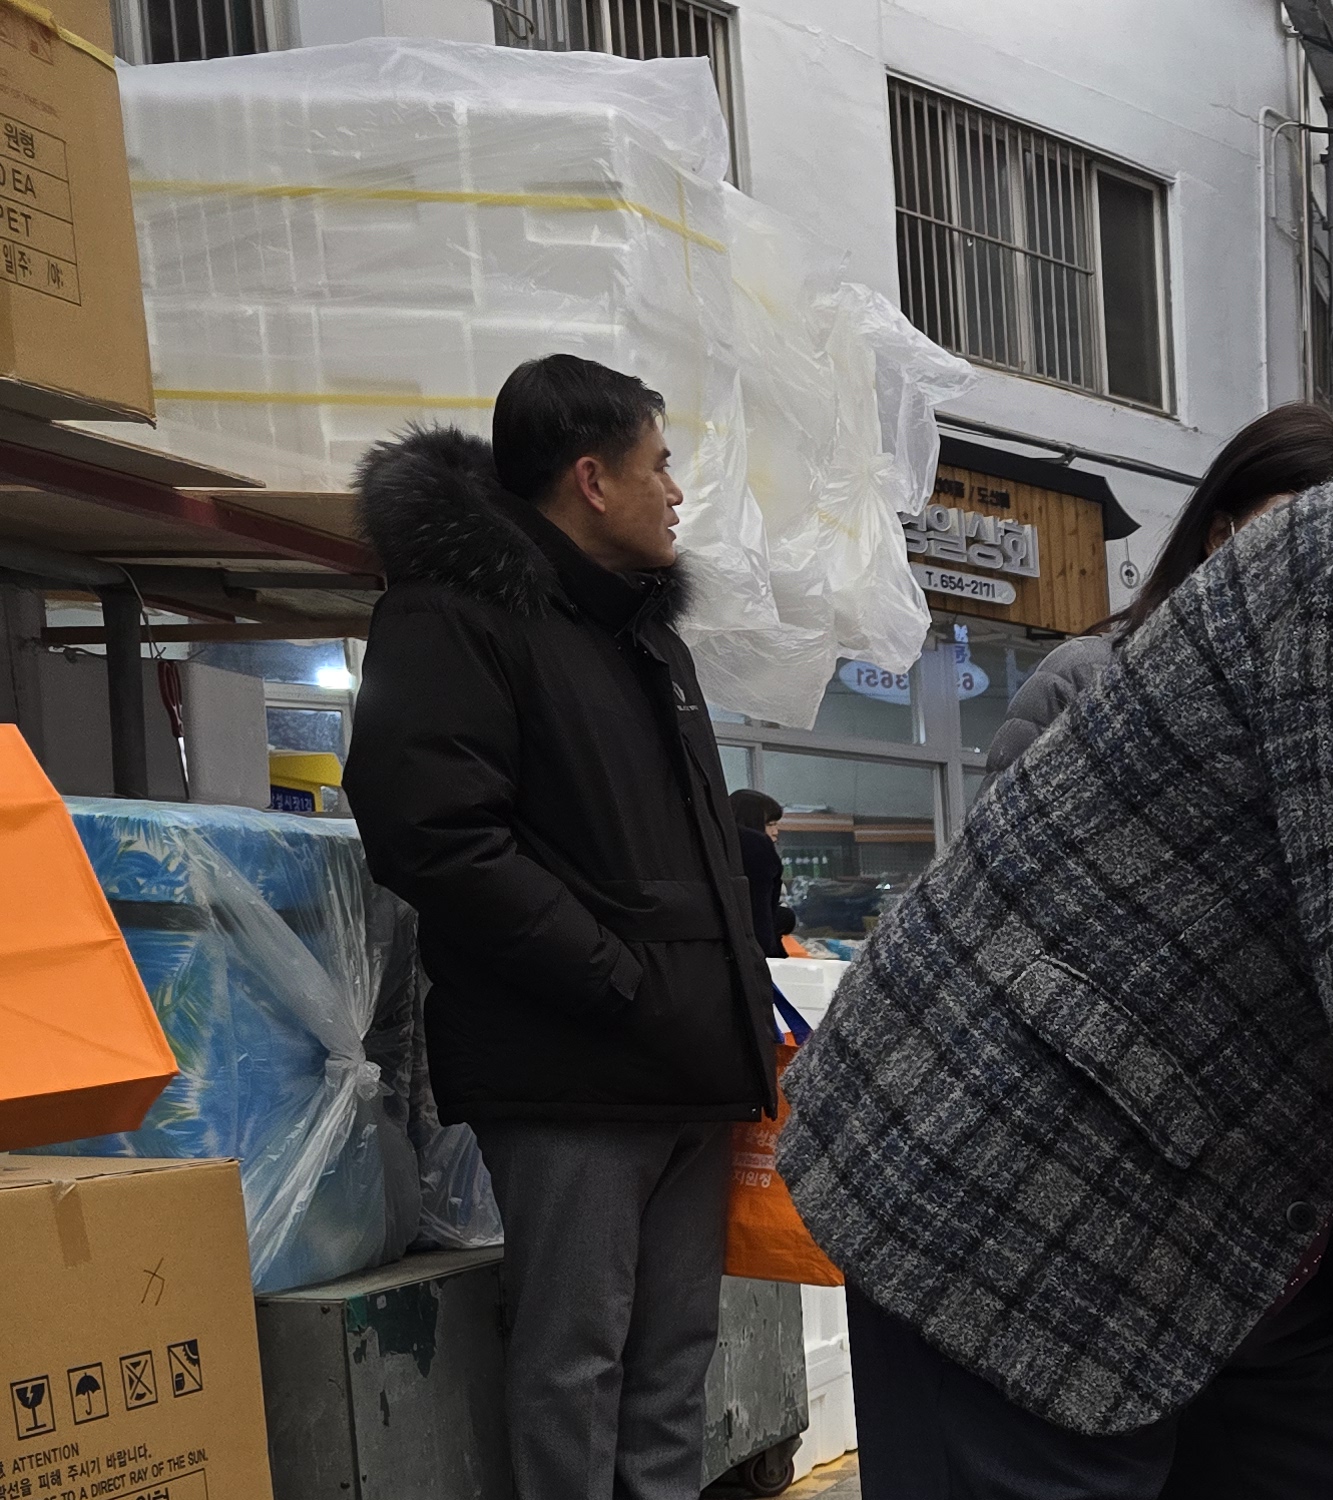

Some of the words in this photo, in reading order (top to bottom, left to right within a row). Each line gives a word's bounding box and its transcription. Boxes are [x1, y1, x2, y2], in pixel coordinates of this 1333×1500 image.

[3, 122, 36, 159] 원형
[12, 170, 37, 199] EA
[12, 1442, 80, 1475] ATTENTION
[38, 1468, 63, 1490] 피해
[67, 1457, 101, 1482] 주시기
[106, 1442, 153, 1470] 바랍니다.
[79, 1486, 89, 1500] A
[90, 1473, 126, 1498] DIRECT
[130, 1466, 149, 1486] RAY
[152, 1461, 165, 1478] OF
[167, 1455, 186, 1473] THE
